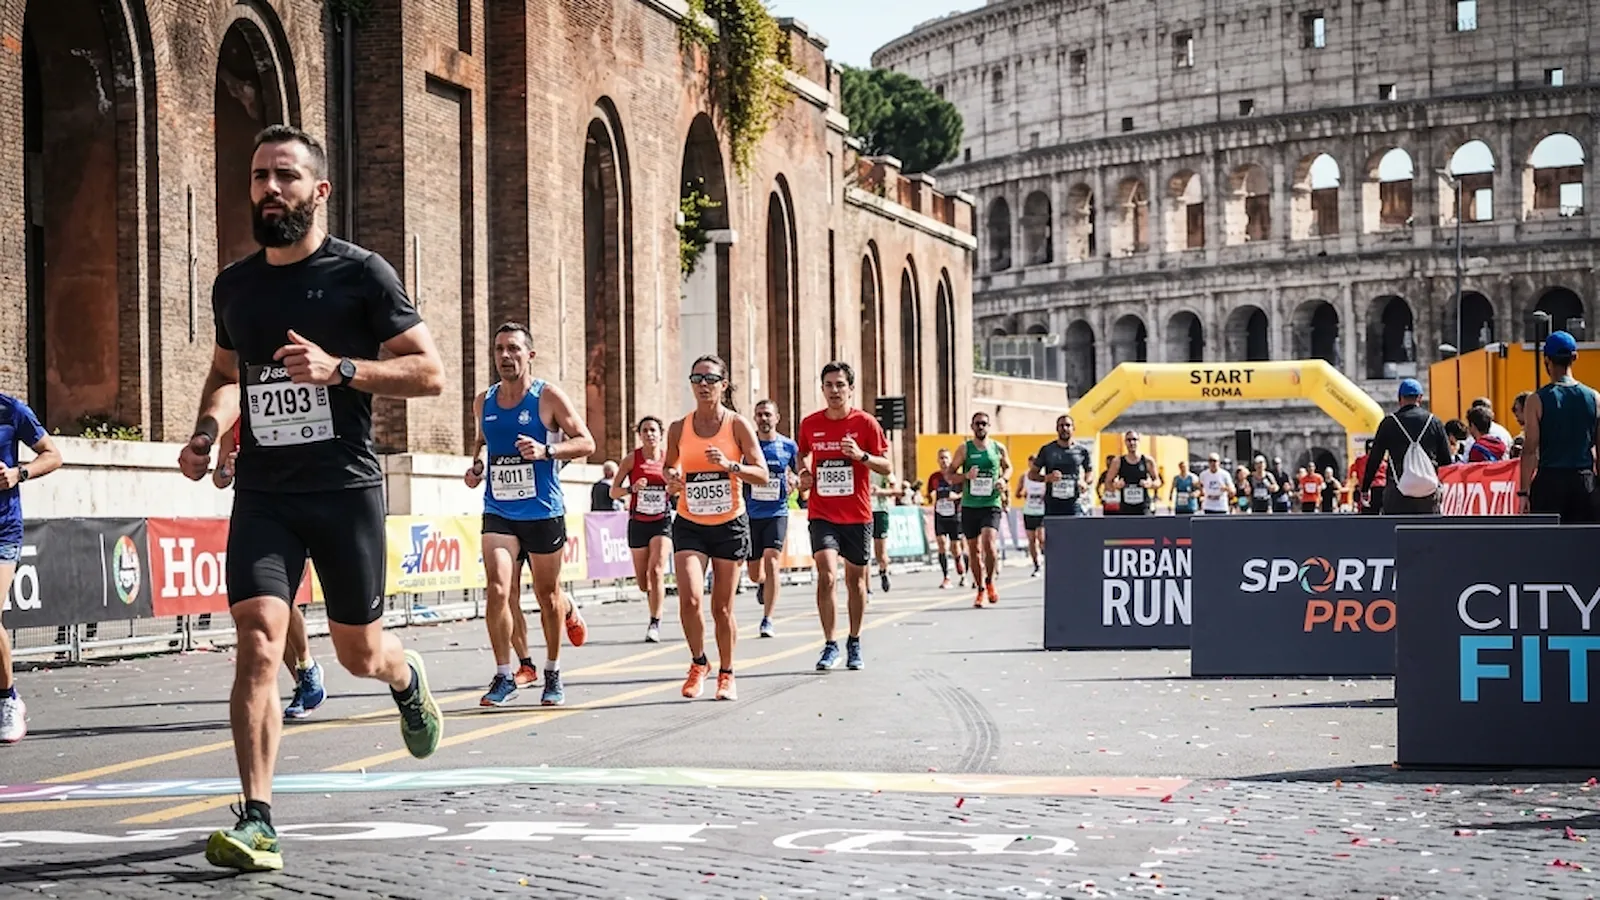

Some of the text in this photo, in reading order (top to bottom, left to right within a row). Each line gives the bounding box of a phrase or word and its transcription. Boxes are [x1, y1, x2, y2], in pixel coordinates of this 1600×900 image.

[1190, 369, 1255, 384] START
[262, 387, 312, 417] 2193
[1202, 387, 1242, 397] ROMA
[498, 469, 522, 483] 4011
[1103, 548, 1192, 577] URBAN
[1102, 579, 1192, 626] RUN
[1303, 599, 1397, 632] PRO
[1457, 583, 1600, 630] CITY
[1460, 635, 1600, 703] FIT
